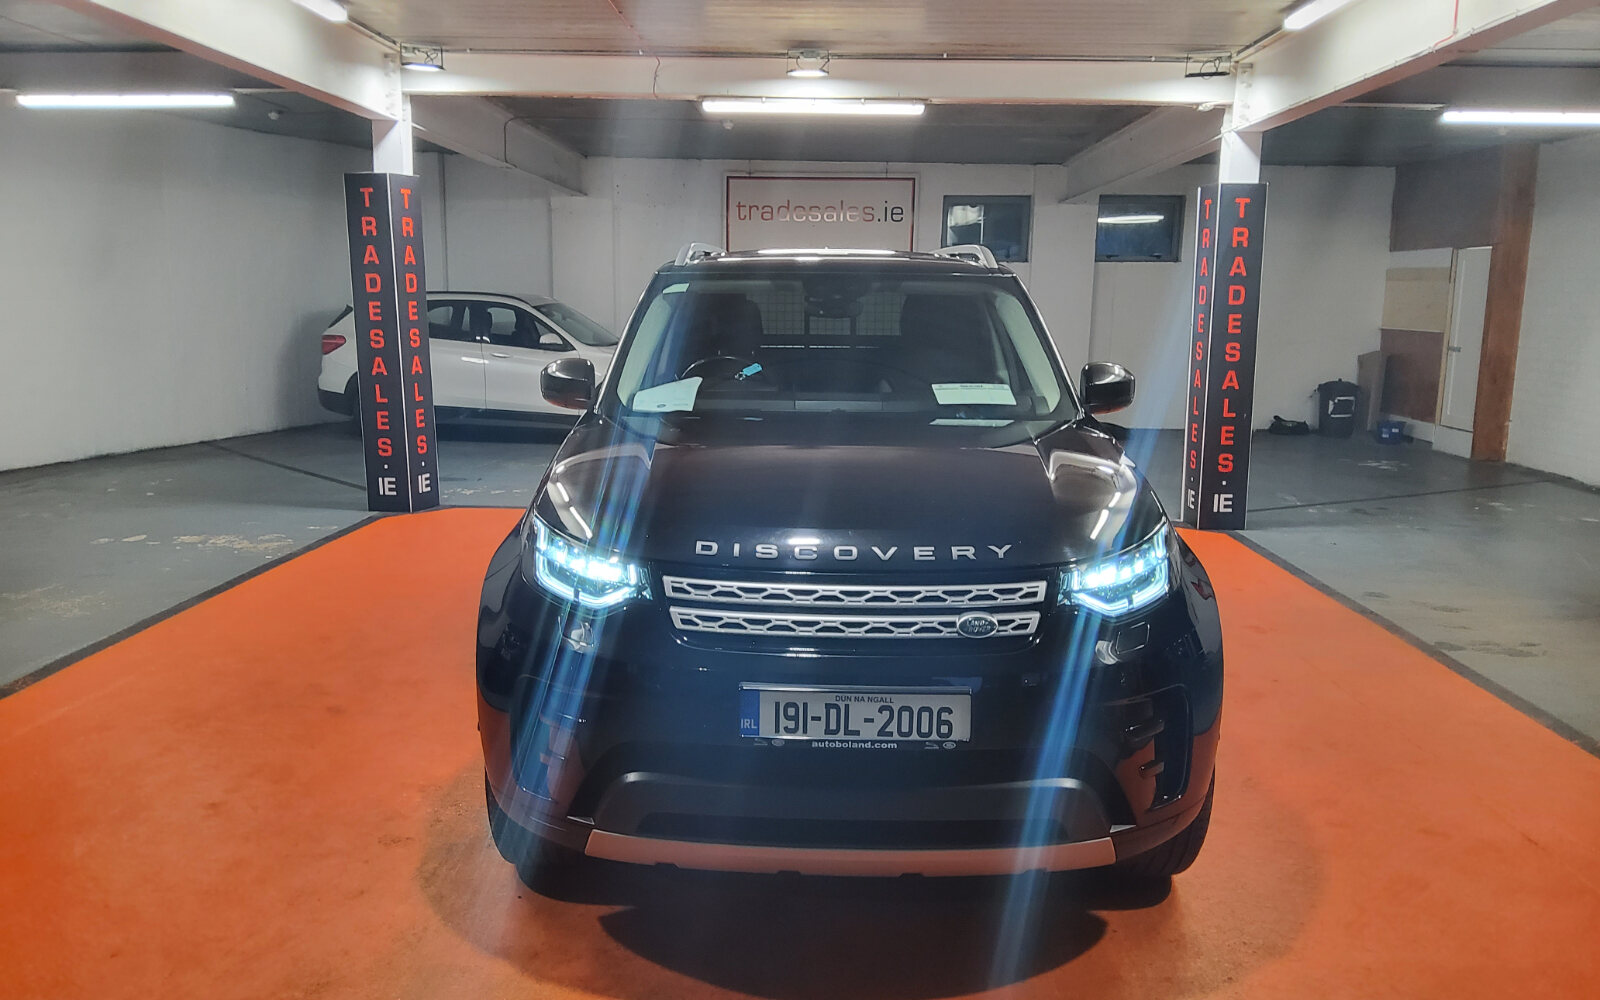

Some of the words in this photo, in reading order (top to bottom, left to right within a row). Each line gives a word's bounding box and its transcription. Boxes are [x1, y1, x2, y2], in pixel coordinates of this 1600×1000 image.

[736, 199, 904, 224] tradesales.ie
[695, 540, 1012, 561] DISCOVERY
[854, 695, 865, 703] NA
[868, 696, 894, 704] NGALL
[740, 718, 757, 729] IRL
[774, 701, 954, 739] 191-DL-2006
[811, 740, 898, 748] autoboland.com
